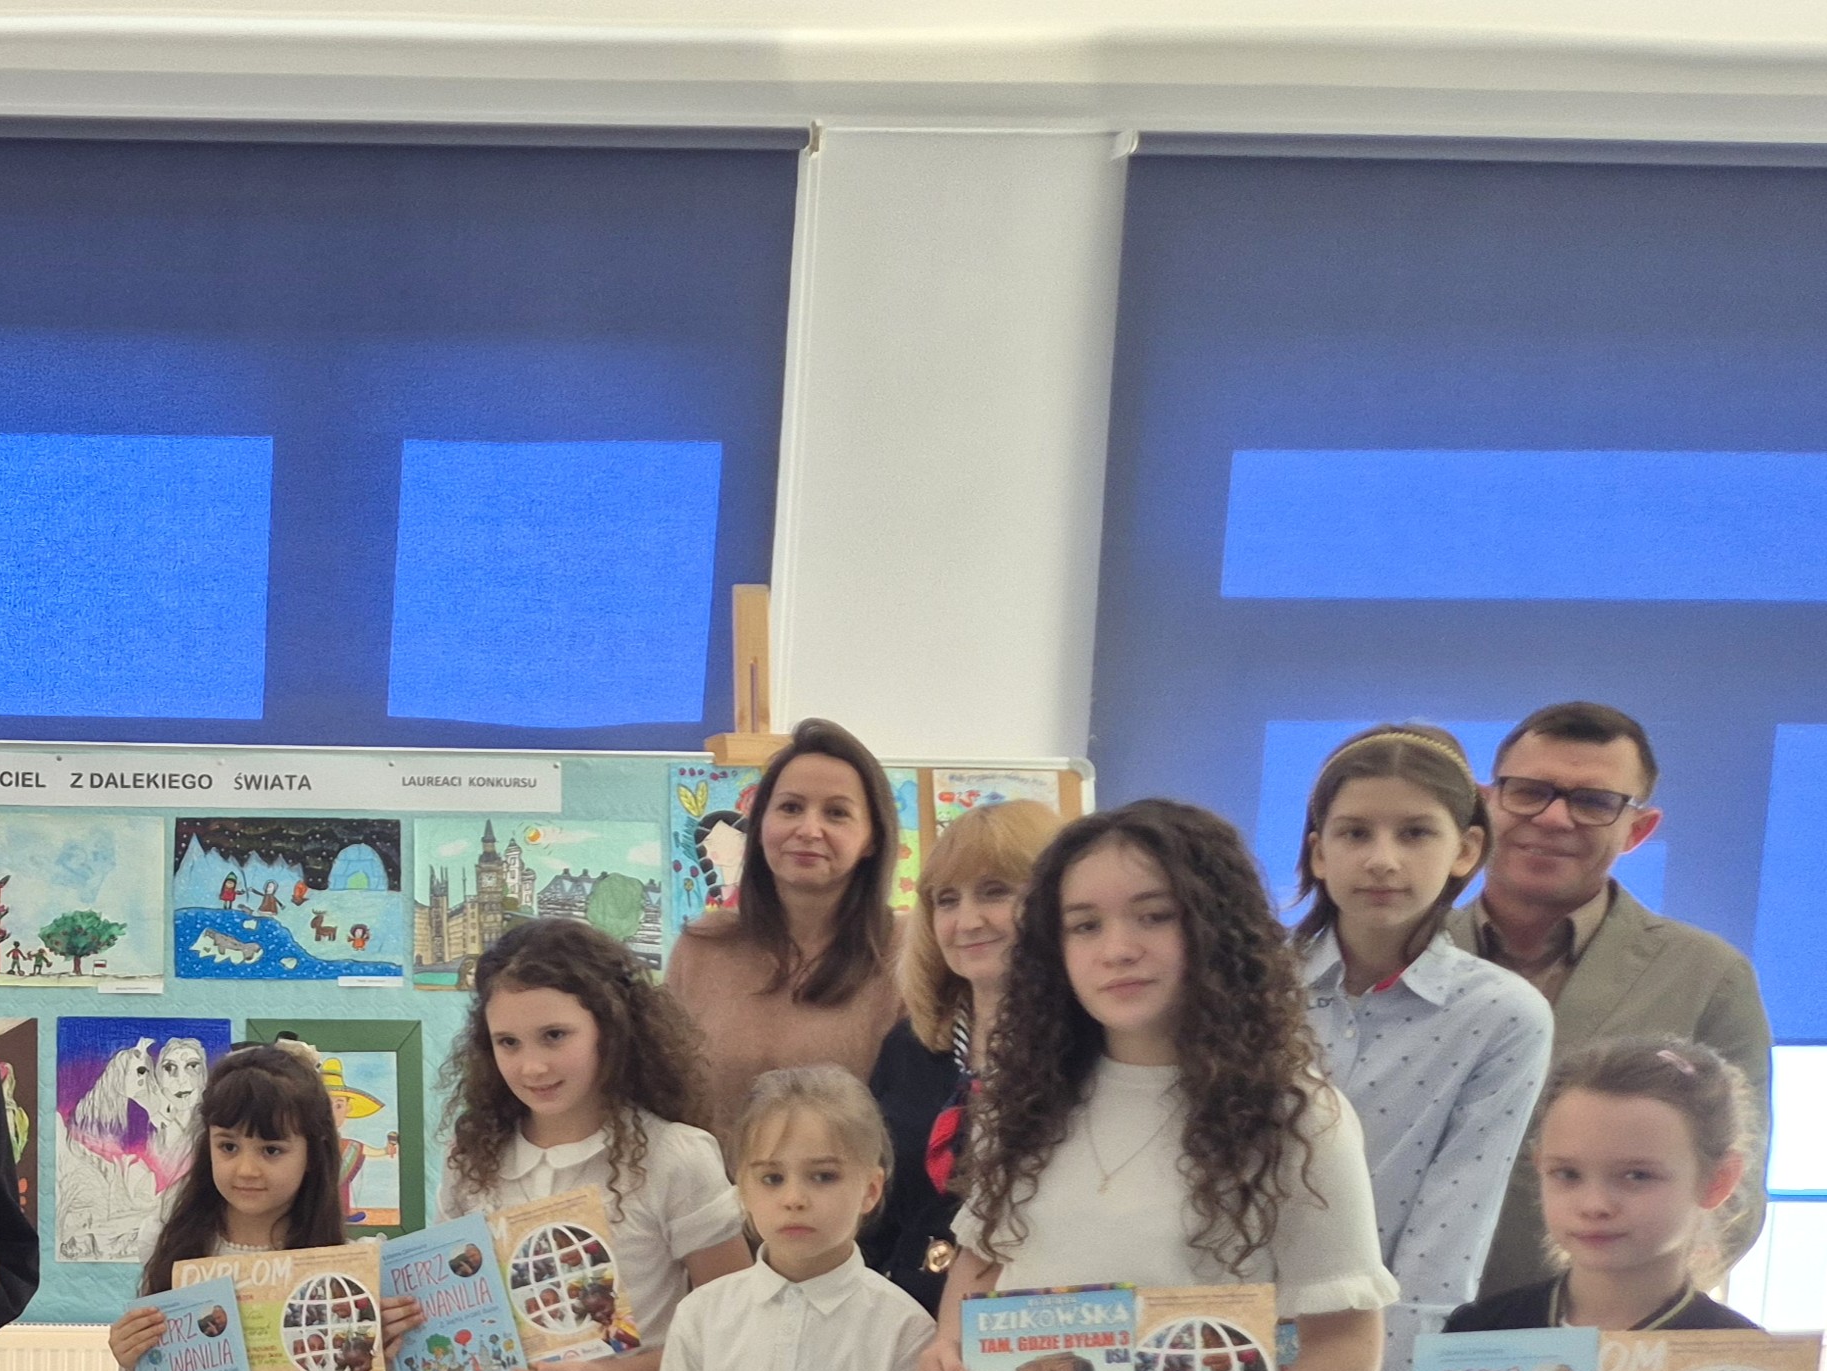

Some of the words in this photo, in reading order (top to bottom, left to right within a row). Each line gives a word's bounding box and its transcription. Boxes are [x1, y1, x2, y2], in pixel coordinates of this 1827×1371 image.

[70, 772, 83, 789] Z
[89, 772, 213, 790] DALEKIEGO
[402, 776, 462, 787] LAUREACI
[468, 776, 538, 788] KONKURSU
[390, 1253, 450, 1295] PIEPRZ
[978, 1304, 1129, 1332] DZIKOWSKA
[1018, 1335, 1060, 1351] GDZIE
[1118, 1331, 1130, 1345] 3
[1105, 1349, 1130, 1364] USA
